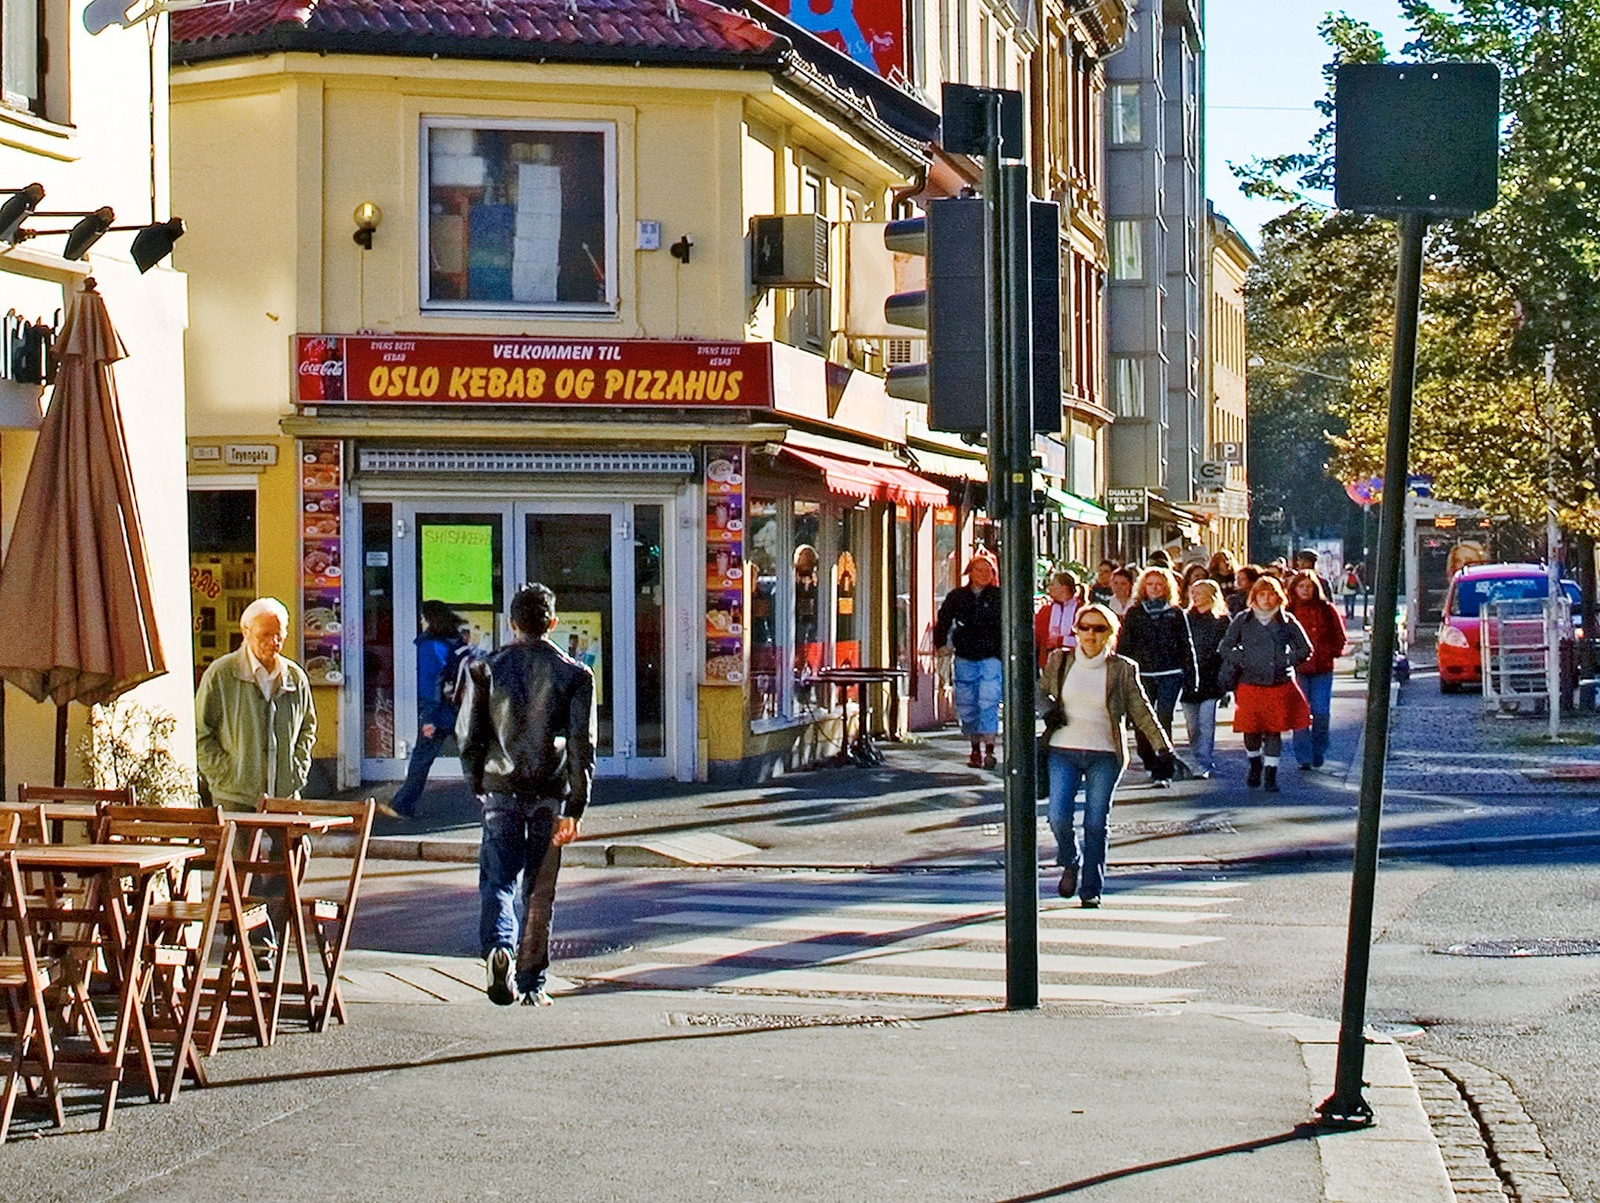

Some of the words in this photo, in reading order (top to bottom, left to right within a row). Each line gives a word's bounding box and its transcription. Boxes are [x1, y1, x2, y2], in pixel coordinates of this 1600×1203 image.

[493, 344, 594, 360] VELKOMMEN
[598, 346, 622, 361] TIL
[369, 365, 439, 397] OSLO
[448, 366, 547, 399] KEBAB
[554, 369, 597, 400] OG
[604, 369, 744, 401] PIZZAHUS
